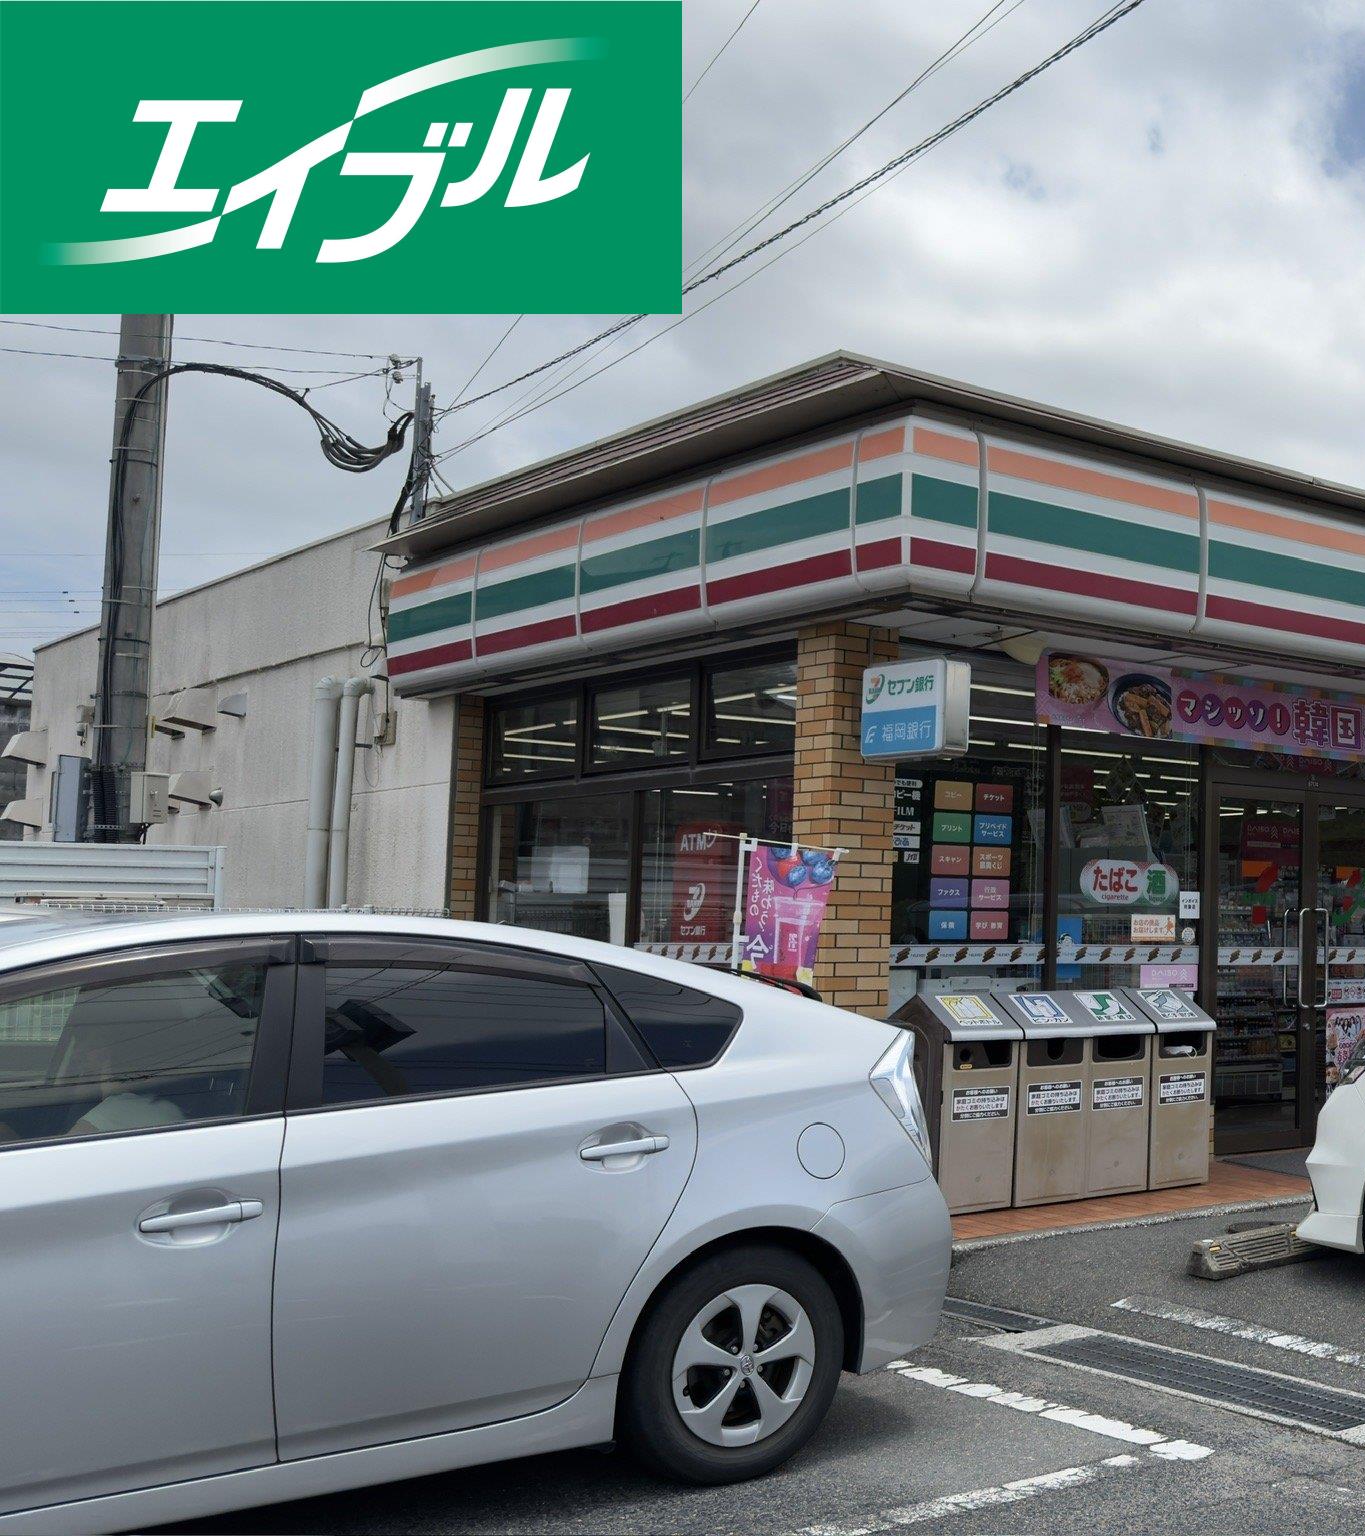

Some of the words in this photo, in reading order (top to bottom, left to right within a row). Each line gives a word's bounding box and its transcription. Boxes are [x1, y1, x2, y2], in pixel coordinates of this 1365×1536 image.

[887, 675, 934, 696] セブン銀行
[882, 720, 931, 742] 福岡銀行
[984, 793, 1005, 801] チケット
[940, 824, 963, 832] プリント
[680, 834, 707, 852] ATM
[939, 856, 962, 864] スキャン
[979, 853, 1004, 862] スポーツ
[1093, 866, 1138, 894] たばこ
[1146, 869, 1167, 894] 酒
[978, 893, 1003, 902] サービス
[1101, 893, 1129, 902] cigarette
[680, 926, 706, 937] セブン銀行
